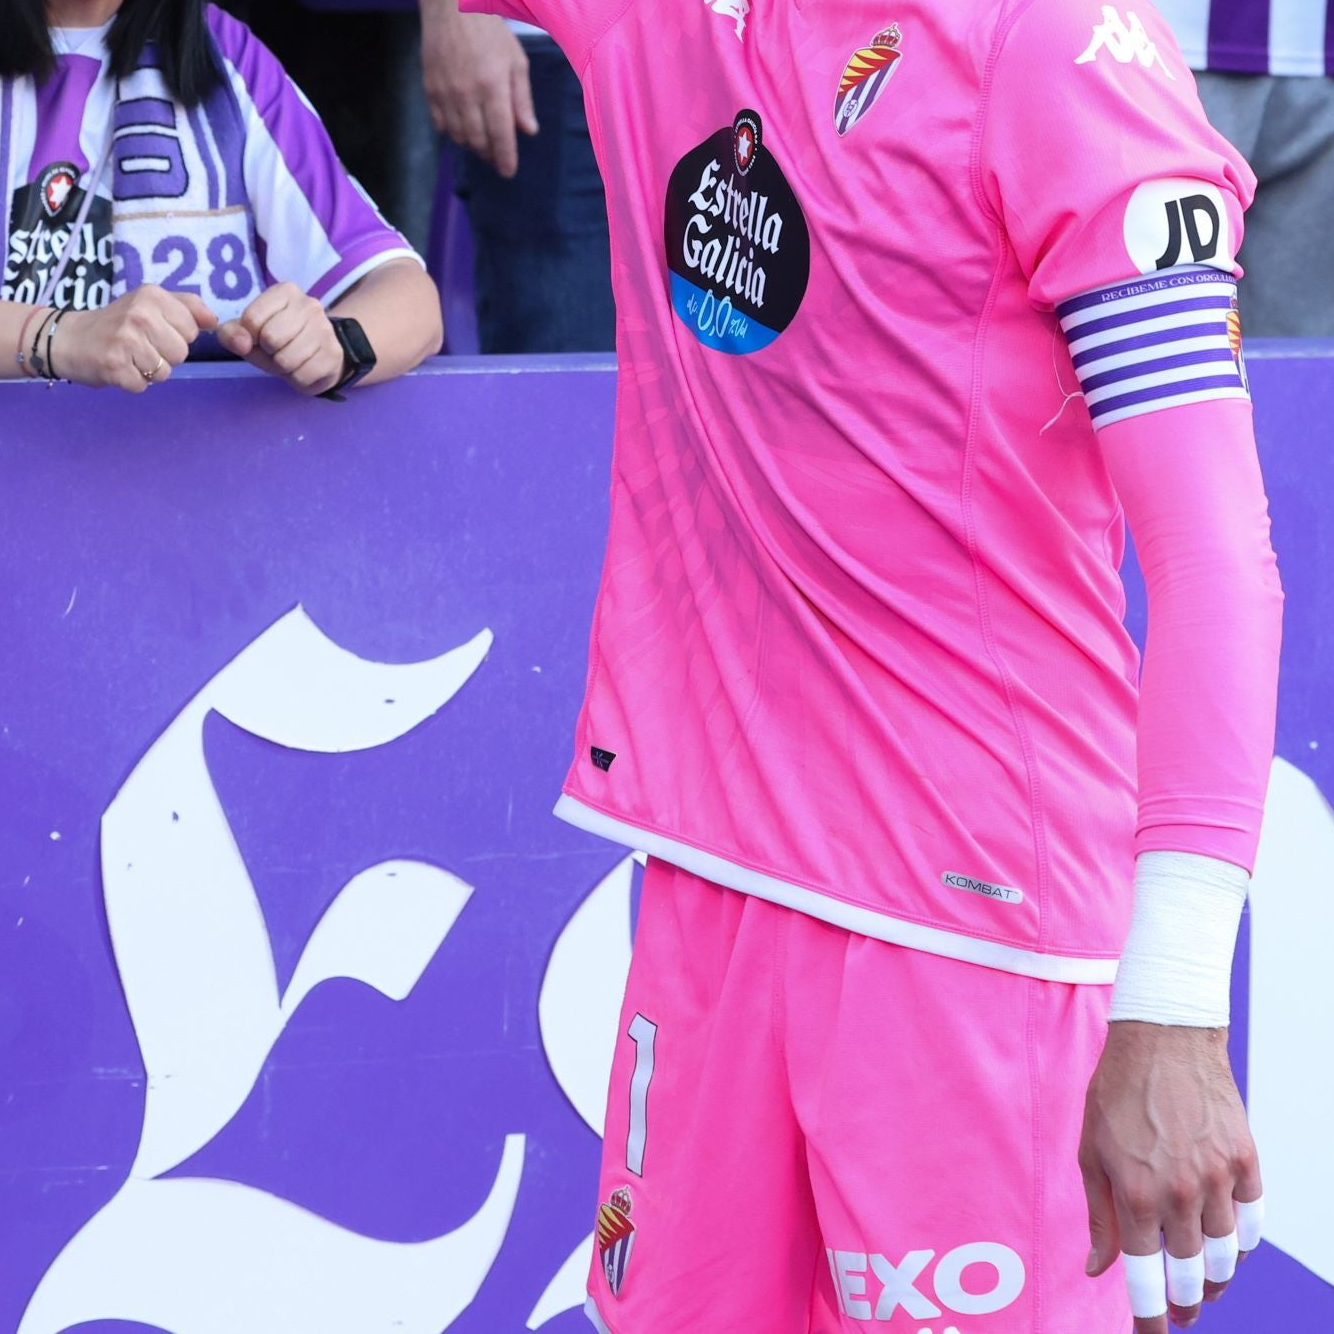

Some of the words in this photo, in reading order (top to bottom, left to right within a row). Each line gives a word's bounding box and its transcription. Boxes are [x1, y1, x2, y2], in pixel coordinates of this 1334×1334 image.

[687, 158, 784, 255] Estrella
[1155, 194, 1220, 271] JD
[683, 213, 767, 309] Galicia
[1101, 279, 1168, 303] RECÍBEME
[1169, 274, 1195, 287] CON
[697, 289, 733, 338] 0,0
[626, 1011, 658, 1178] 1
